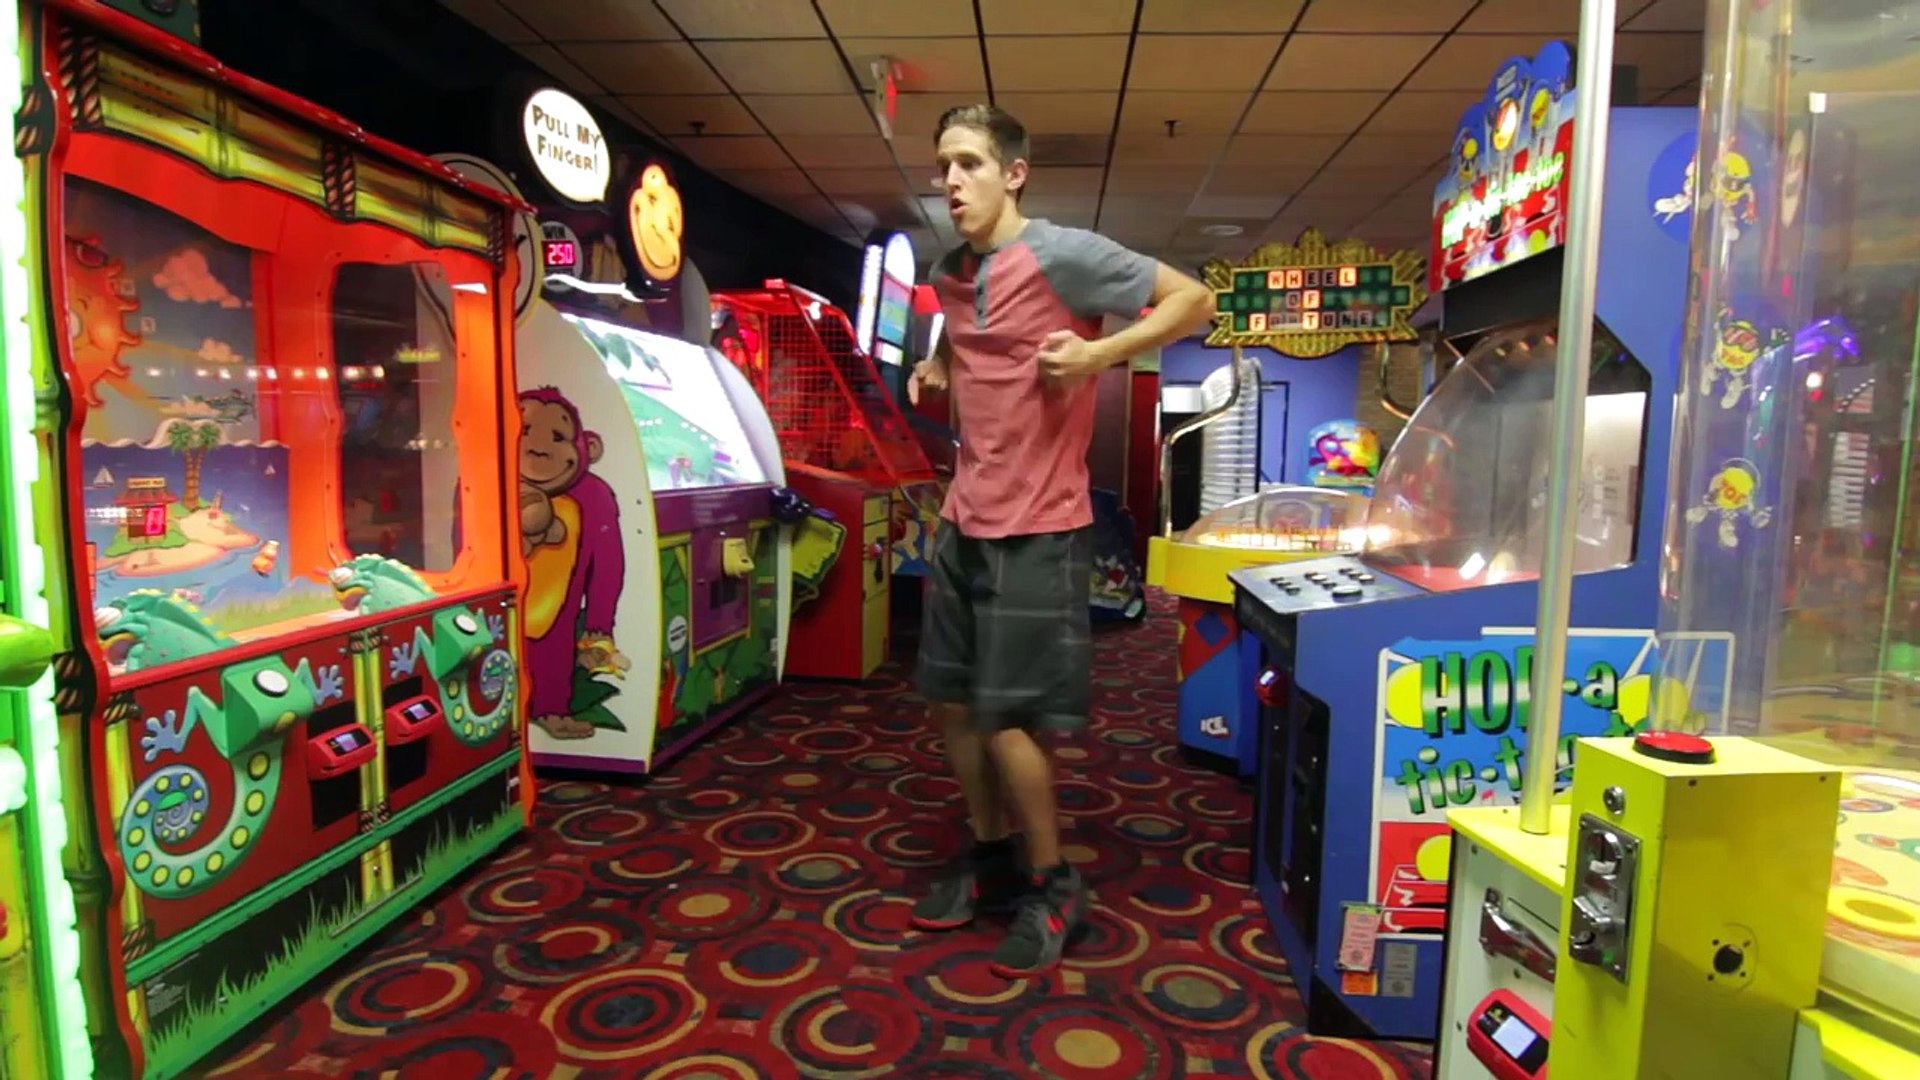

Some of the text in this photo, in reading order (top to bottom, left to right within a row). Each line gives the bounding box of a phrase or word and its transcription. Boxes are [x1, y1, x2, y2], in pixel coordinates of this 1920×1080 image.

[547, 243, 574, 265] 250
[1270, 269, 1353, 287] WHEEL
[1287, 291, 1318, 307] OF
